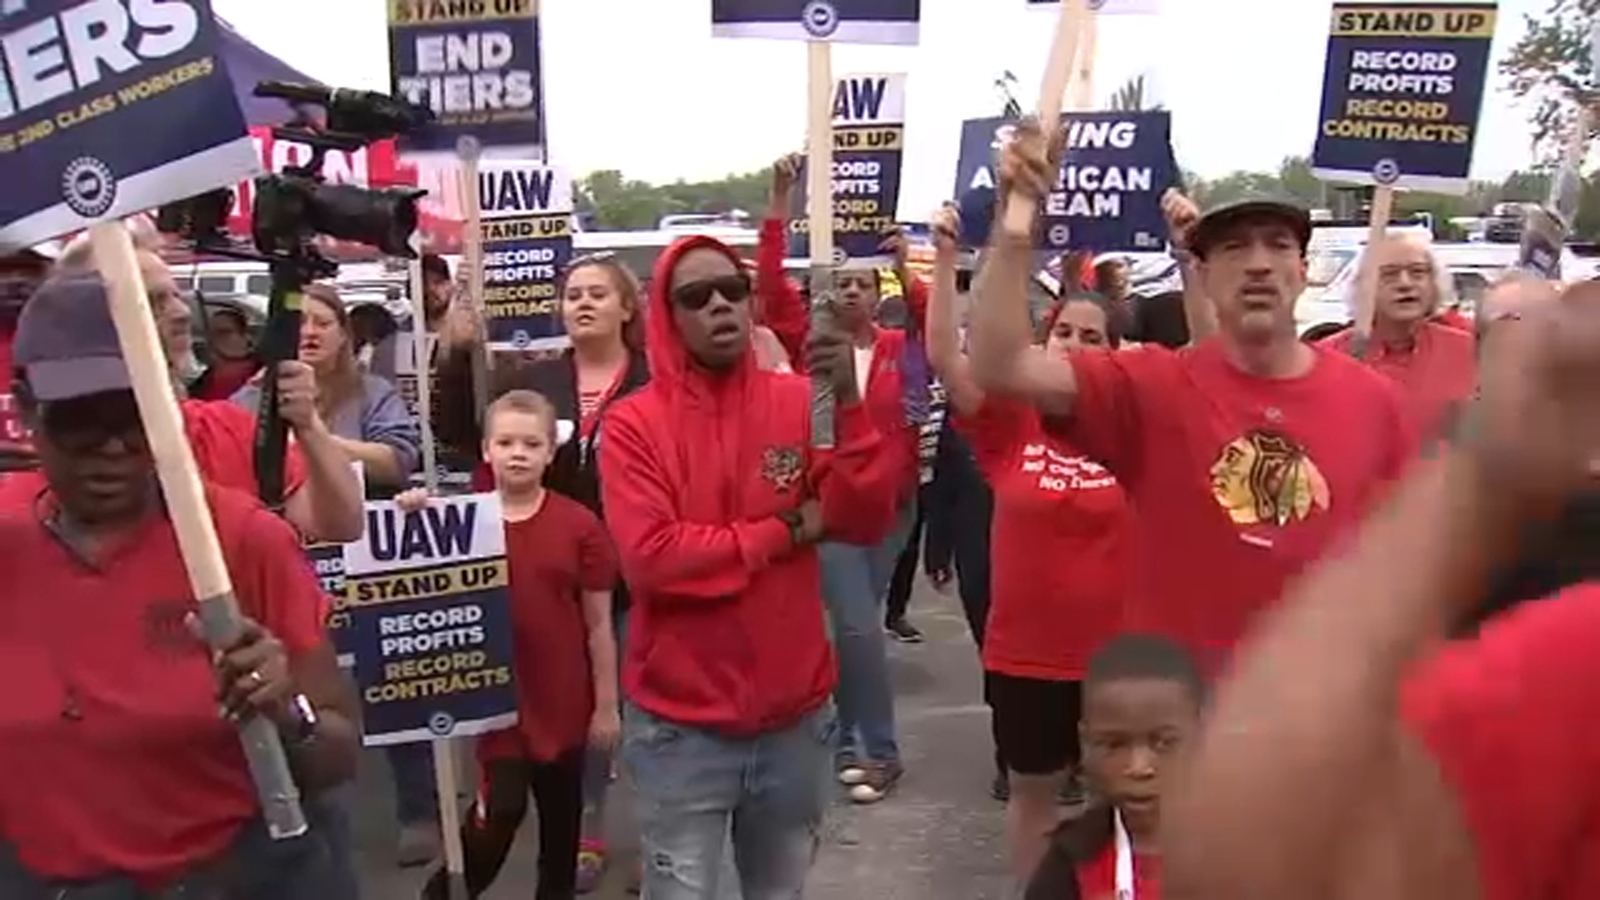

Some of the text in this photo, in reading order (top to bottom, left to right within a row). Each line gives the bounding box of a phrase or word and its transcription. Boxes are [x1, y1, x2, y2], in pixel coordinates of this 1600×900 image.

[1339, 13, 1485, 33] STAND UP
[416, 32, 513, 72] END
[1352, 51, 1457, 71] RECORD
[56, 94, 116, 129] CLASS
[117, 56, 214, 106] WORKERS
[397, 70, 534, 117] TIERS
[1349, 74, 1453, 94] PROFITS
[832, 78, 887, 120] AW
[1346, 100, 1448, 120] RECORD
[867, 132, 897, 146] UP
[990, 121, 1138, 149] SING
[1322, 119, 1469, 144] CONTRACTS
[832, 161, 880, 177] CORD
[970, 165, 1152, 191] AICAN
[479, 169, 554, 212] UAW
[832, 179, 880, 194] OFITS
[1044, 191, 1121, 217] EAM
[481, 218, 567, 240] TAND UP
[367, 504, 477, 561] UAW
[357, 573, 453, 602] STAND
[461, 565, 498, 589] UP
[379, 605, 483, 636] RECORD
[381, 626, 485, 657] PROFITS
[384, 650, 486, 681] RECORD
[364, 666, 510, 704] CONTRACTS
